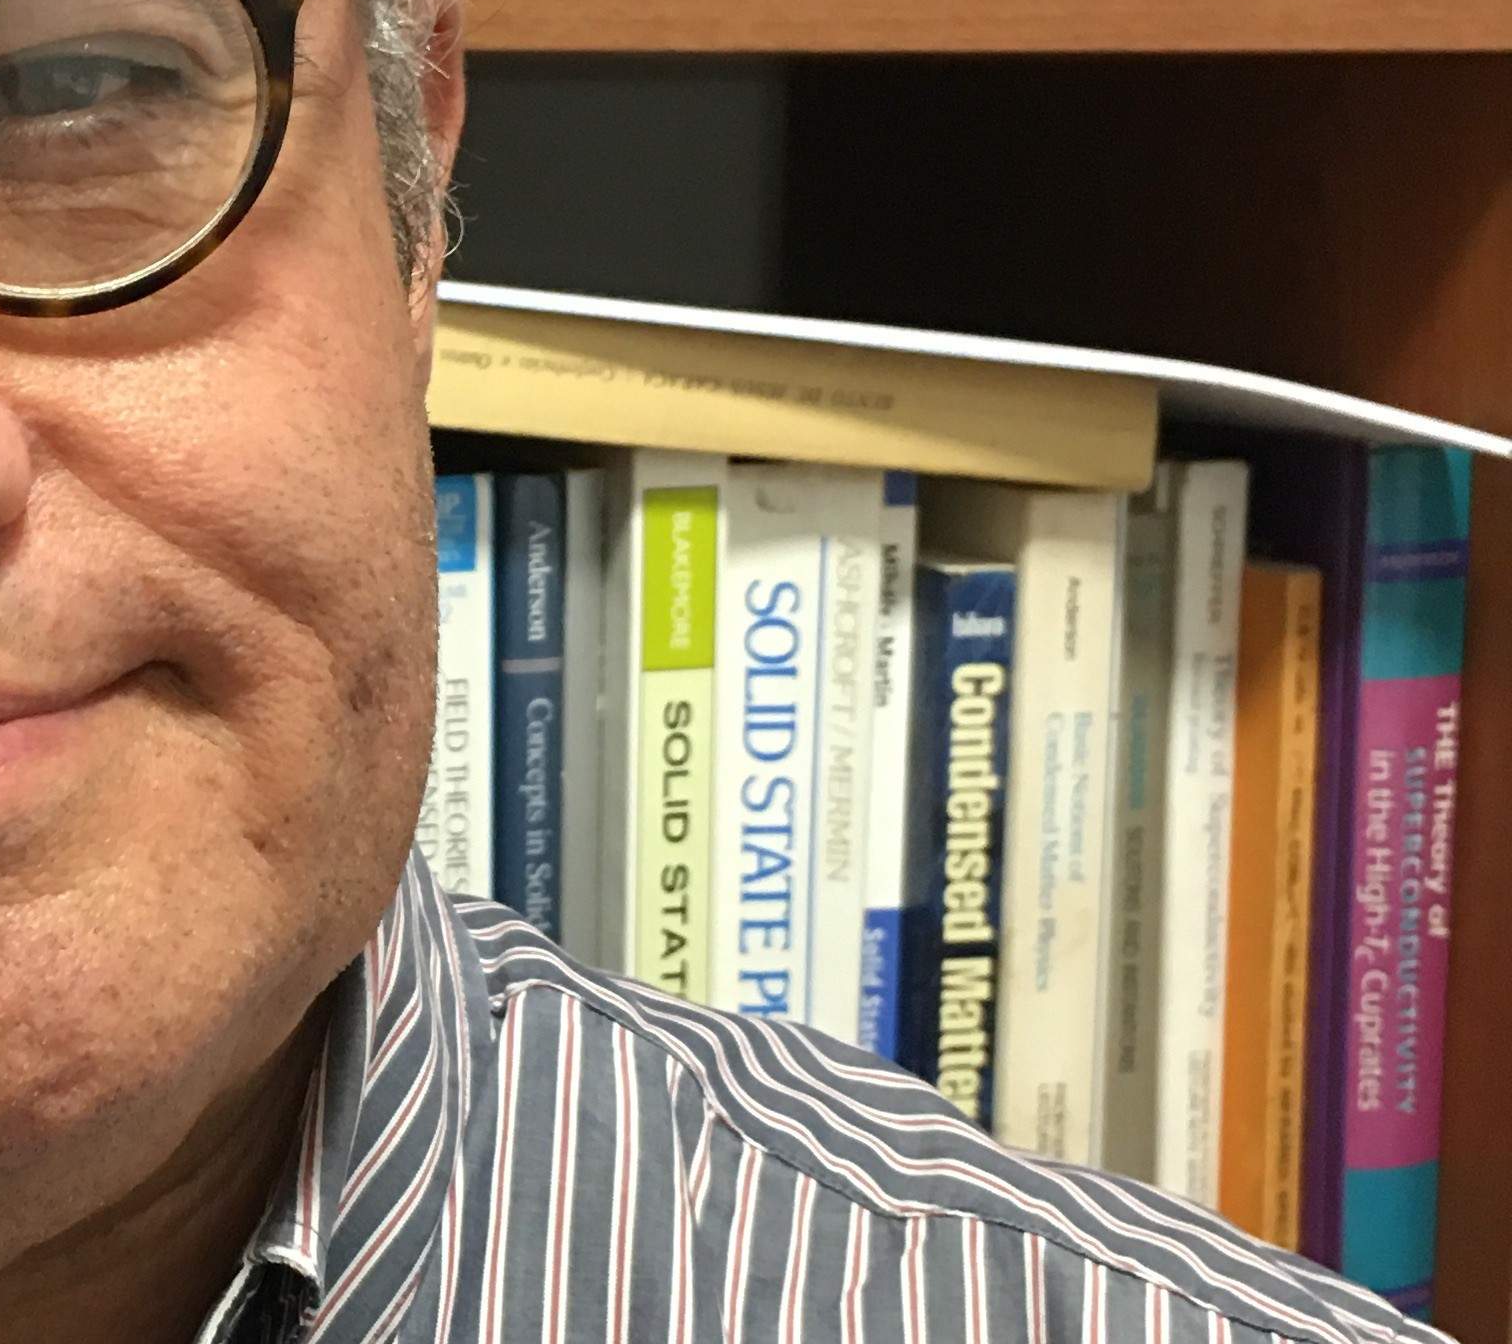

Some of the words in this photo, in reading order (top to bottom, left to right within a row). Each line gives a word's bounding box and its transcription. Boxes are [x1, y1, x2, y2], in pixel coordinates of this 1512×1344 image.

[527, 518, 554, 643] Anderson
[443, 677, 469, 753] FIELD
[741, 578, 801, 763] SOLID
[521, 696, 556, 828] Concepts
[662, 699, 694, 844] SOLID
[941, 662, 1006, 944] Condensed
[1367, 748, 1397, 782] in
[525, 831, 554, 863] in
[739, 775, 797, 954] STATE
[1425, 778, 1456, 895] Theory
[659, 864, 692, 1000] STAT
[1395, 744, 1427, 1115] SUPERCONDUCTIVITY
